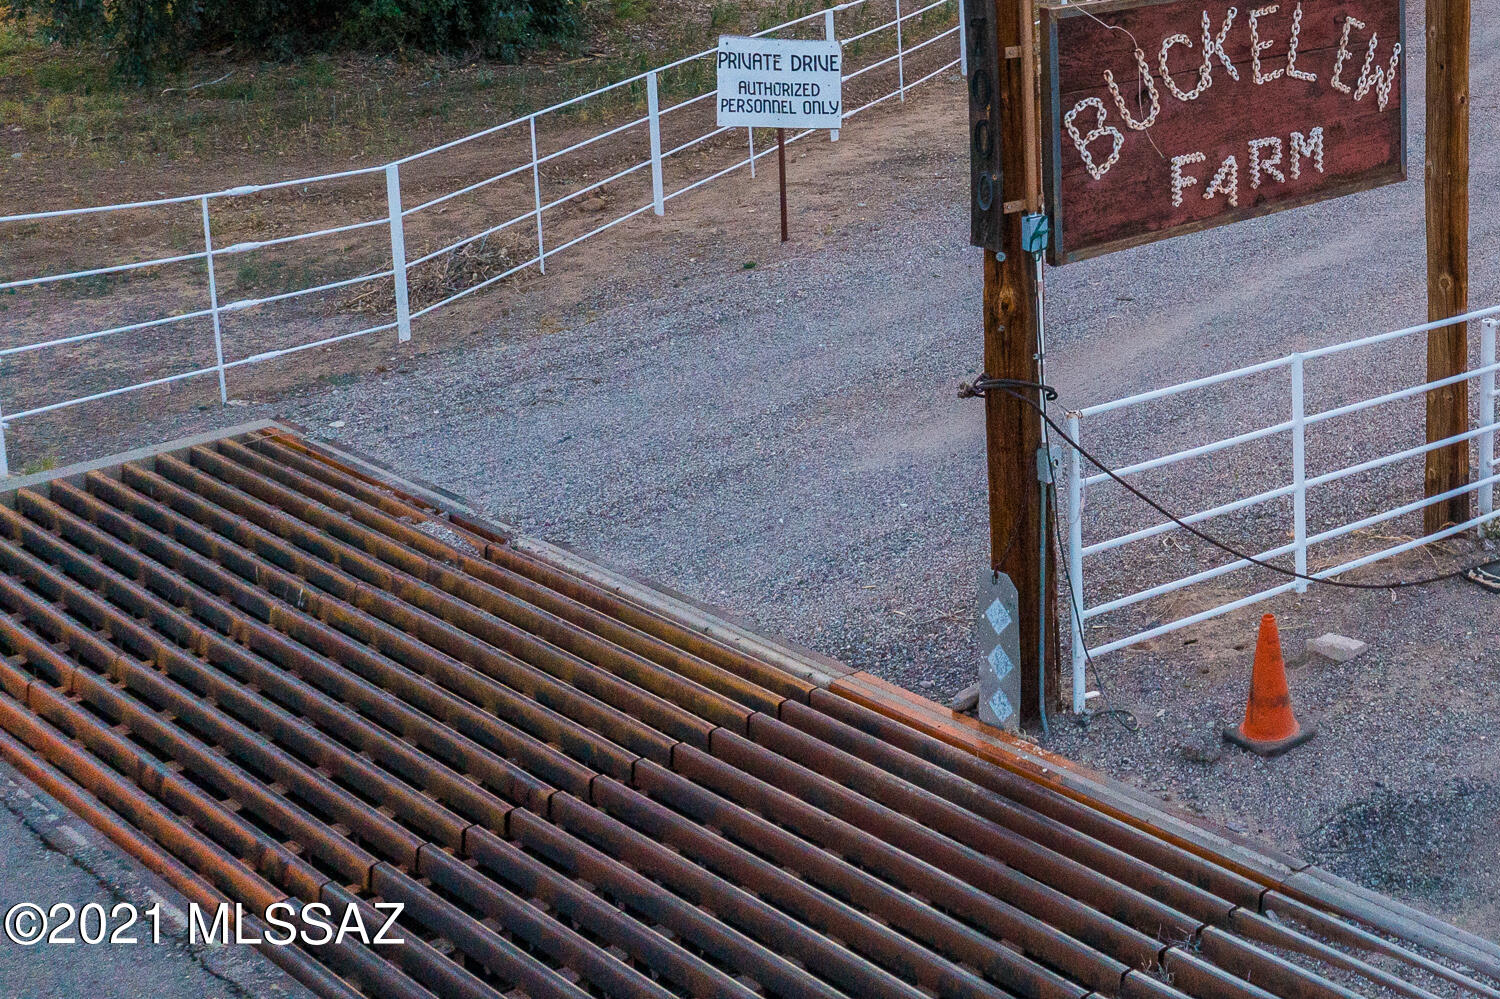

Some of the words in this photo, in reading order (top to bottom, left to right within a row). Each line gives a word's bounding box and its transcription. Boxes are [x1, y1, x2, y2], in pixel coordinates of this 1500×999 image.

[718, 52, 782, 71] PRIVATE
[791, 54, 839, 72] DRIVE
[738, 80, 820, 97] AUTHORIZED
[1064, 1, 1401, 180] BUCKELEW
[720, 98, 796, 115] PERSONNEL
[803, 100, 839, 115] ONLY
[1170, 126, 1324, 207] FARM
